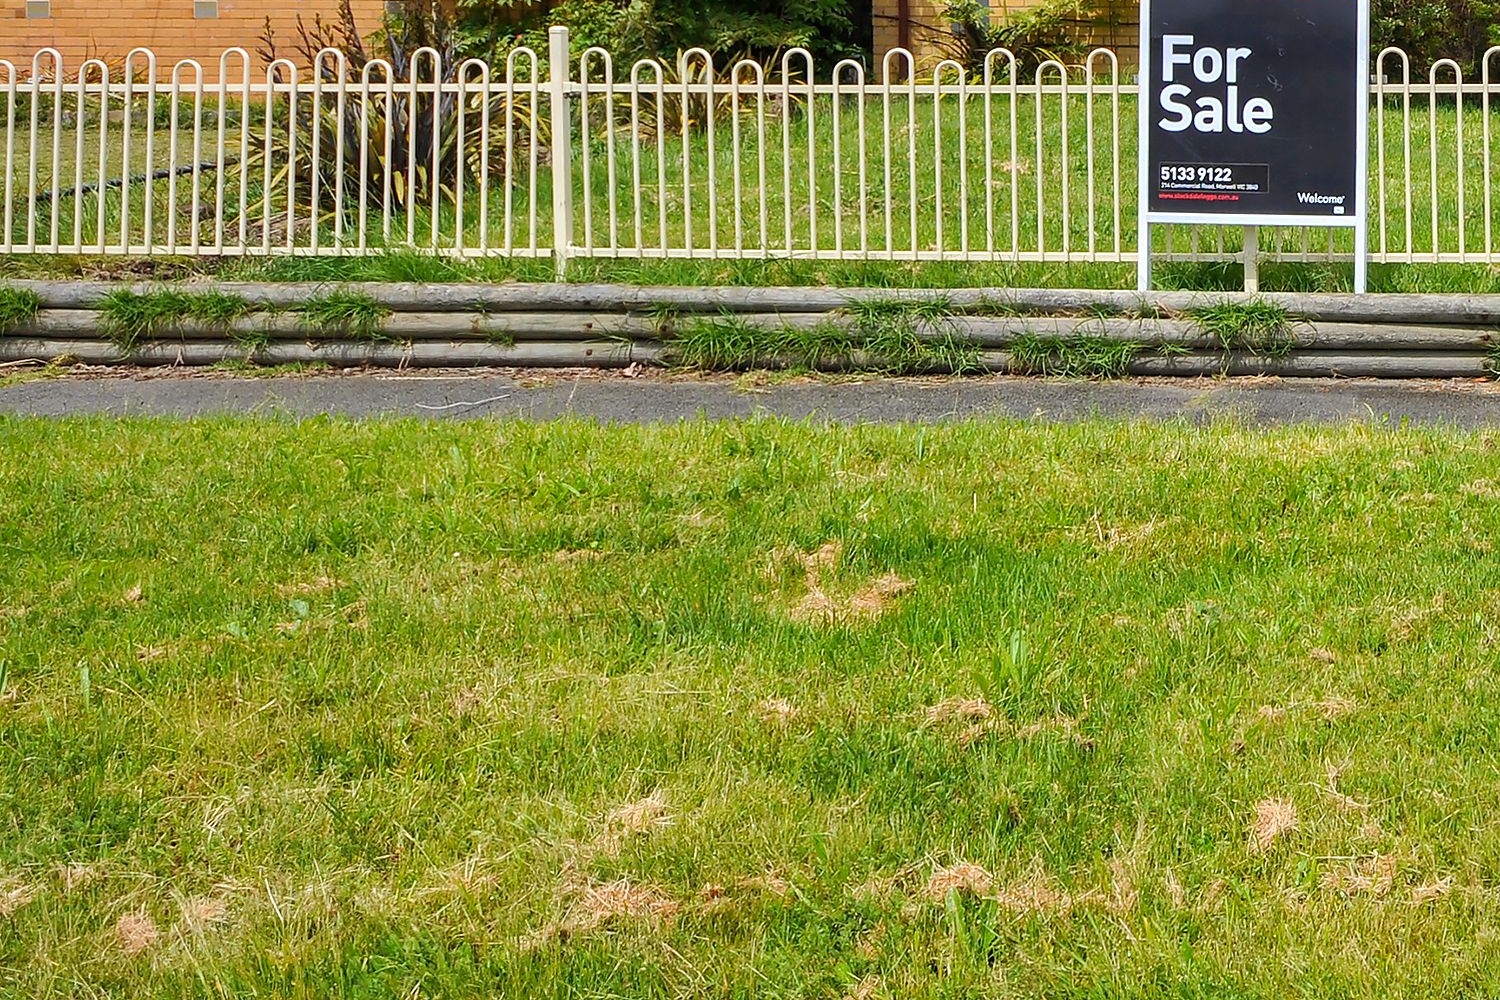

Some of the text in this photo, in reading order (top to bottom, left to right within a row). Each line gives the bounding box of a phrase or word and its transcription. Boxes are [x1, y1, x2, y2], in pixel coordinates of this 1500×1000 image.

[1161, 34, 1252, 84] For
[1158, 83, 1274, 134] Sale
[1160, 166, 1233, 182] 5133 9122
[1297, 192, 1344, 204] Welcome
